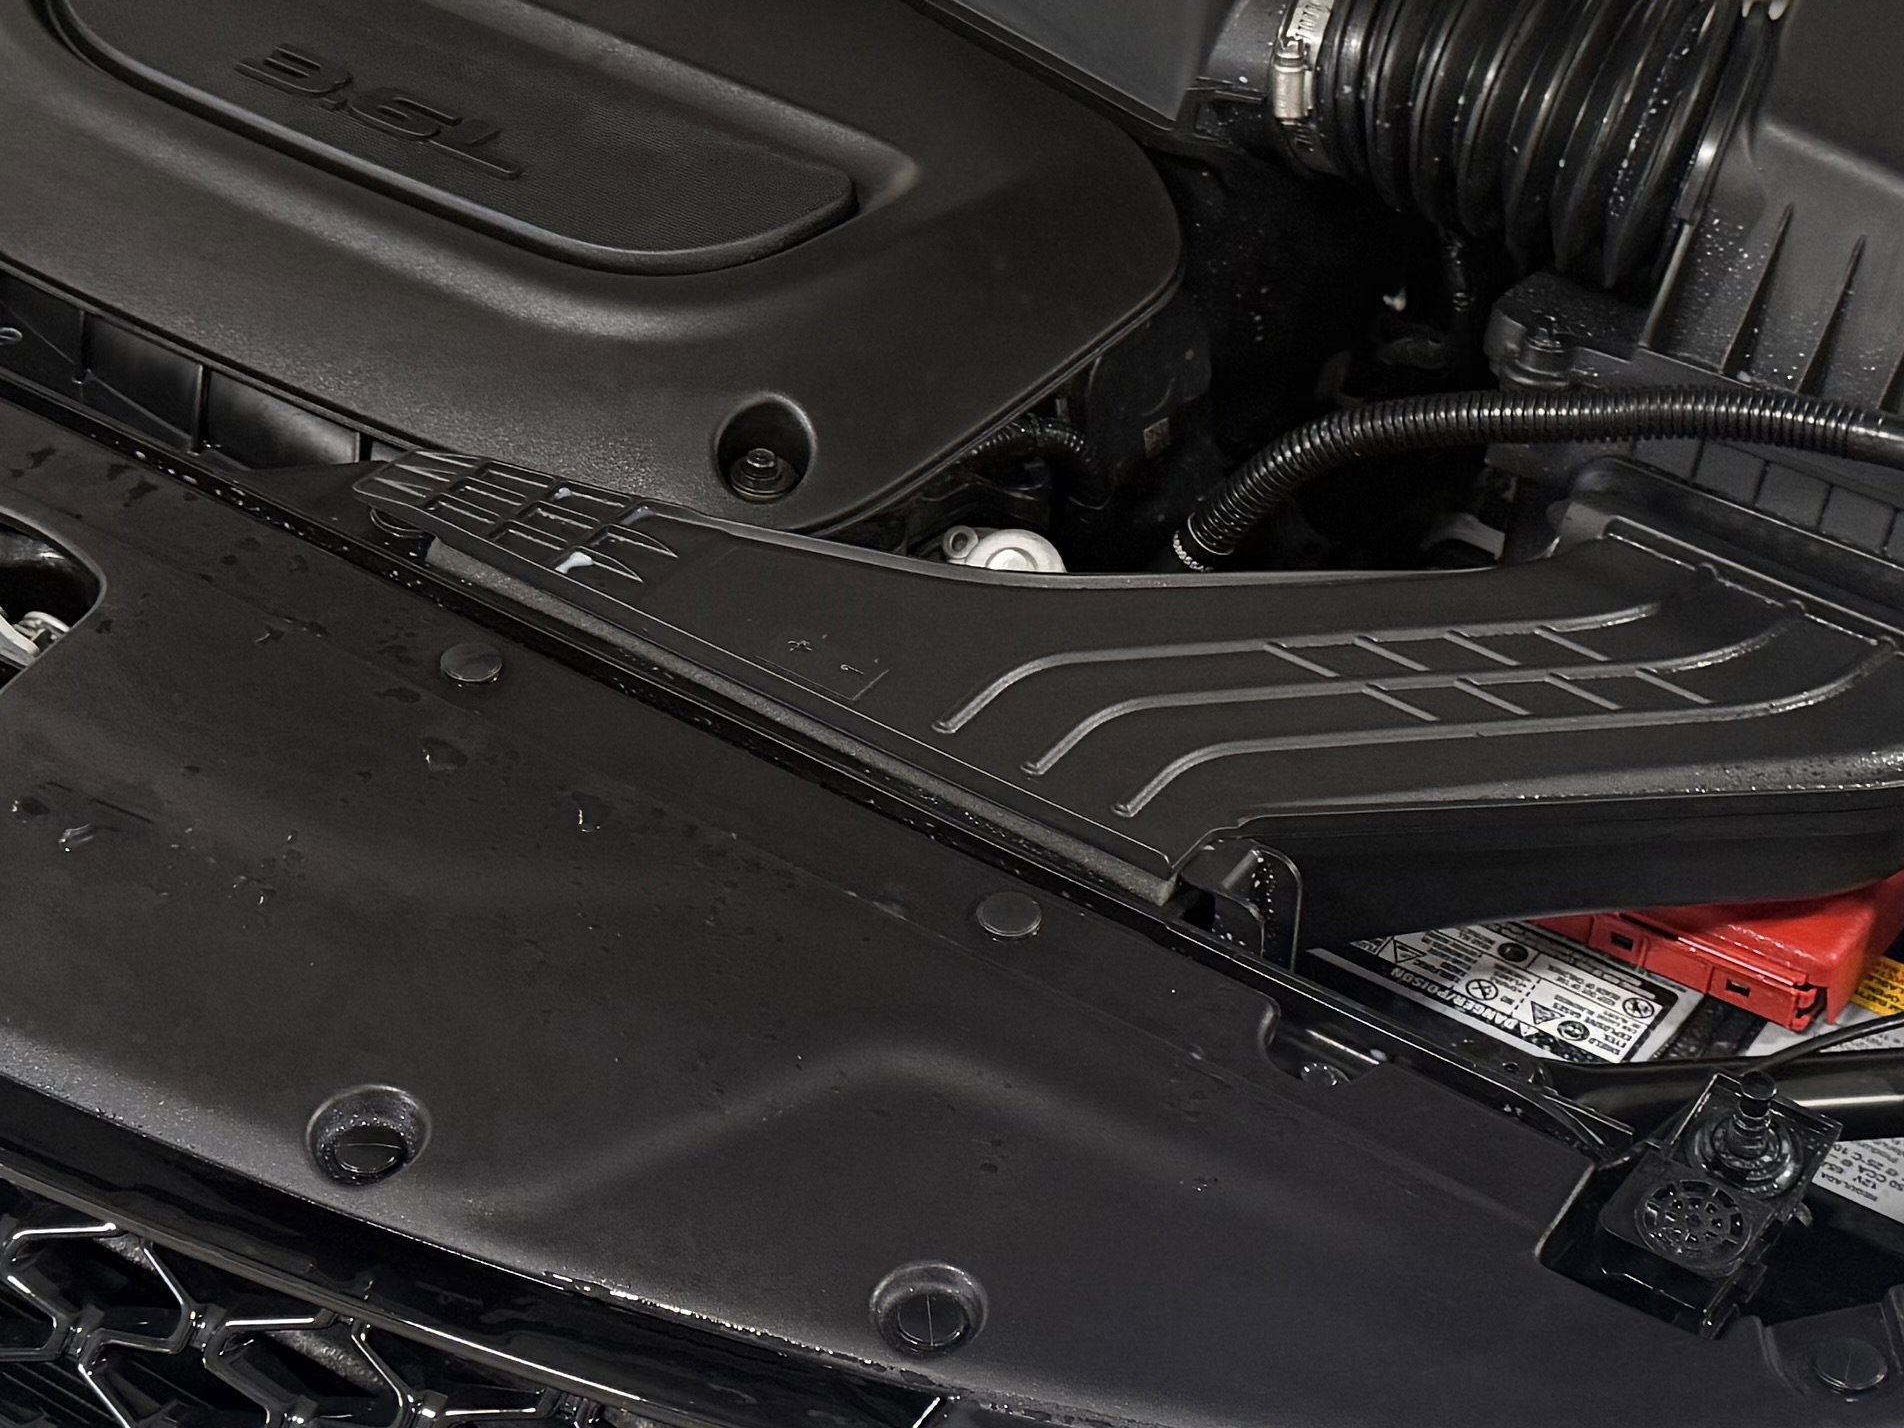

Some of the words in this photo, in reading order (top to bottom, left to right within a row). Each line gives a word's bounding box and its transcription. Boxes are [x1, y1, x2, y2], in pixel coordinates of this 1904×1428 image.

[234, 42, 529, 181] 3.6L
[1390, 967, 1518, 1030] DANGER/POISON
[1852, 1176, 1877, 1189] 12V
[1858, 1165, 1887, 1183] CCA
